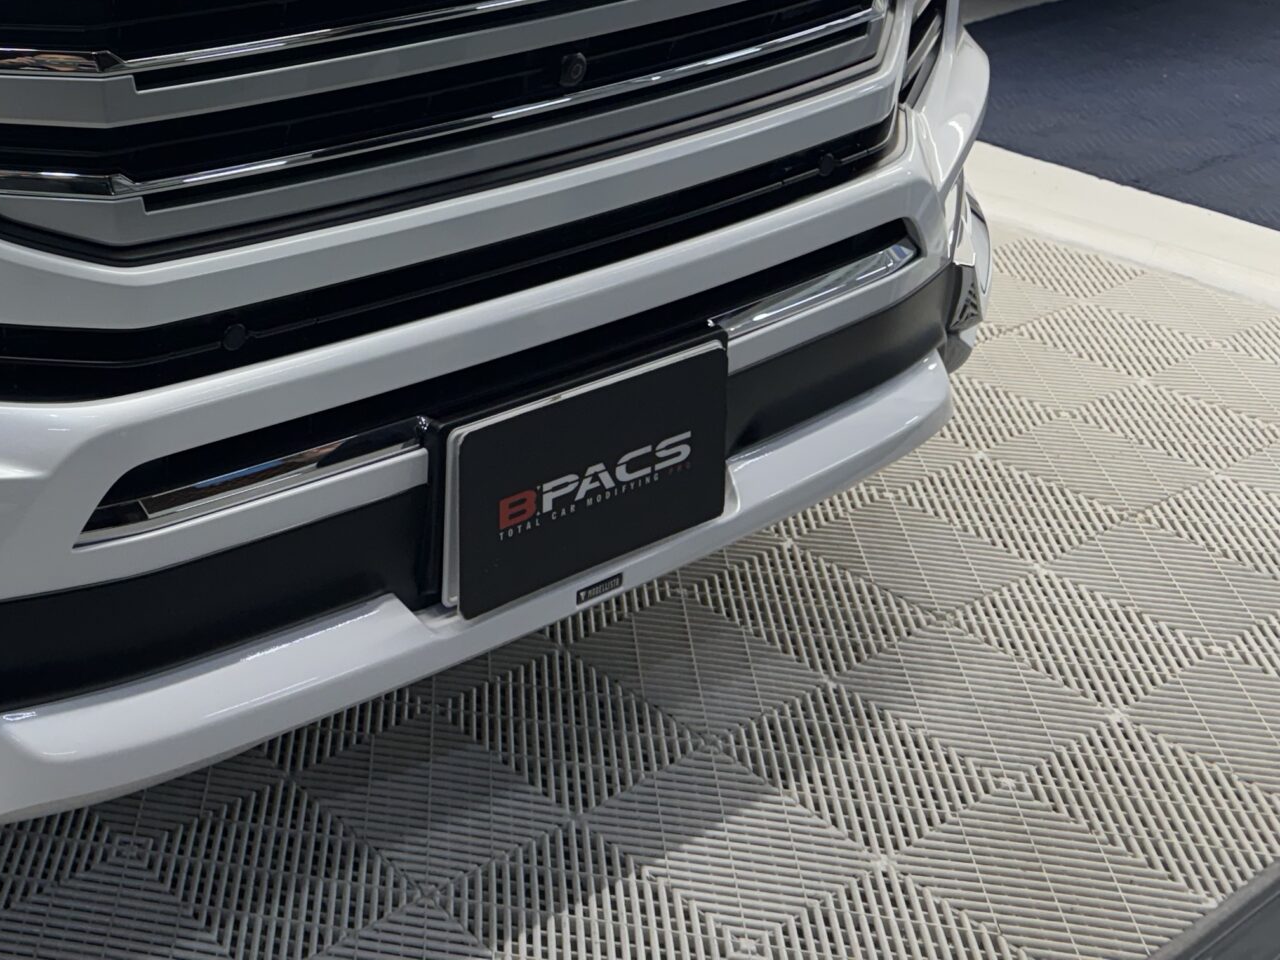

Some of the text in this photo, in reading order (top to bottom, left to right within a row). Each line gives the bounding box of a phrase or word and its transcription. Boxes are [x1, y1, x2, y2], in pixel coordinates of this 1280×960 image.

[499, 518, 541, 541] TOTAL
[551, 504, 576, 520] CAR
[586, 472, 659, 507] MODIFYING
